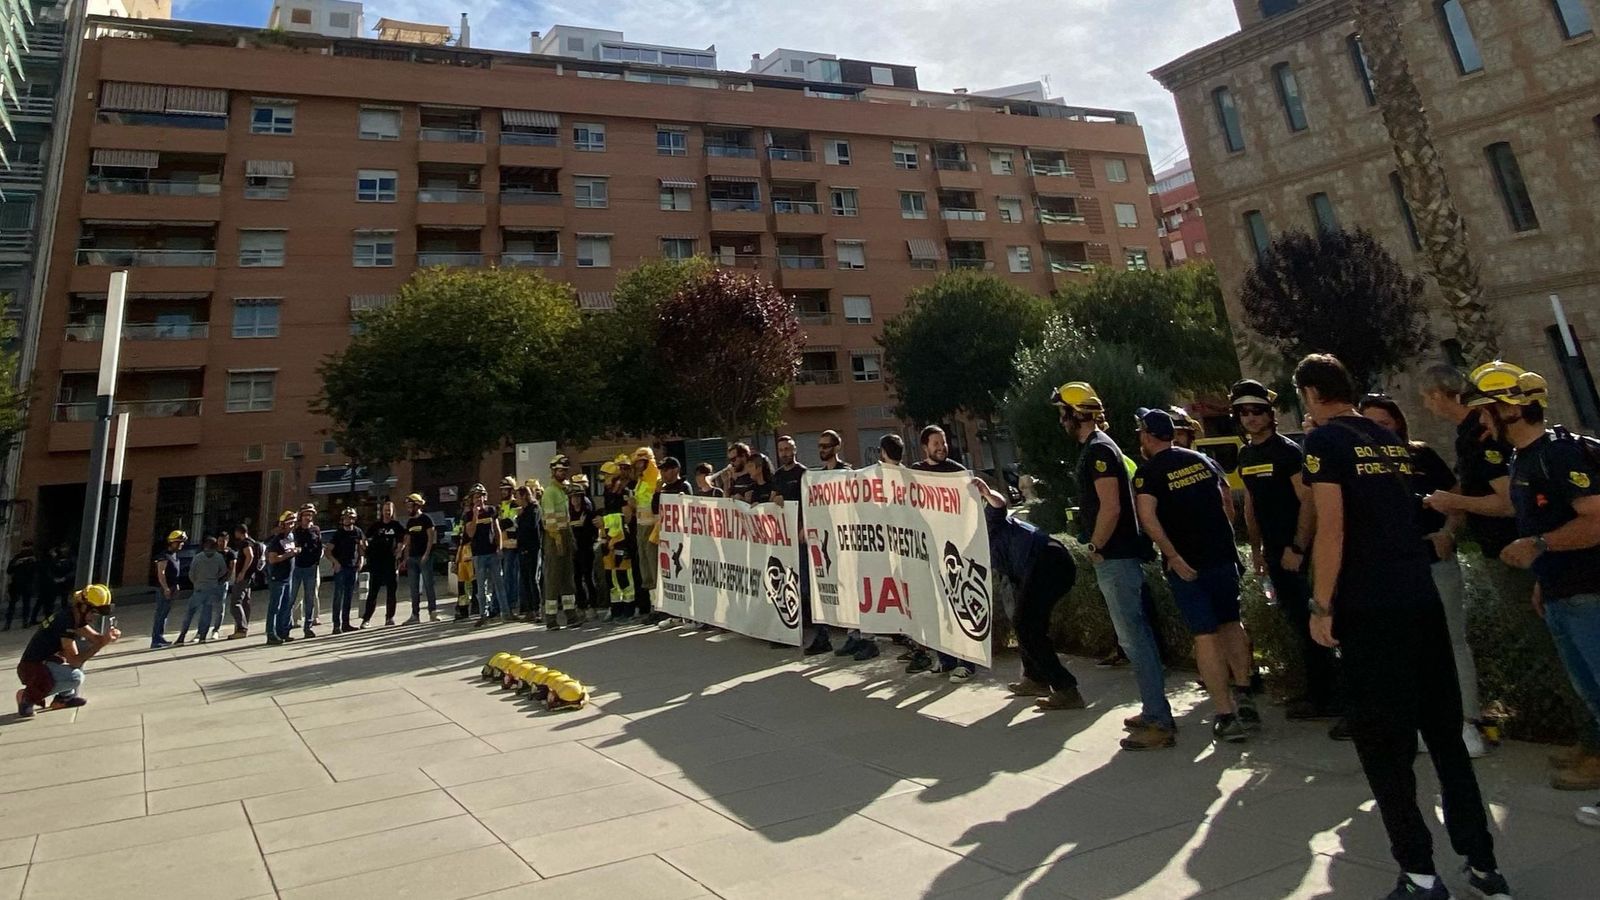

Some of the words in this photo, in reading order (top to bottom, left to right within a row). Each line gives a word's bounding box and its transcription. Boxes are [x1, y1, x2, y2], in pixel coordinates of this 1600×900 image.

[891, 480, 907, 505] 1er
[910, 482, 961, 515] CONVENI
[859, 576, 912, 620] JA!
